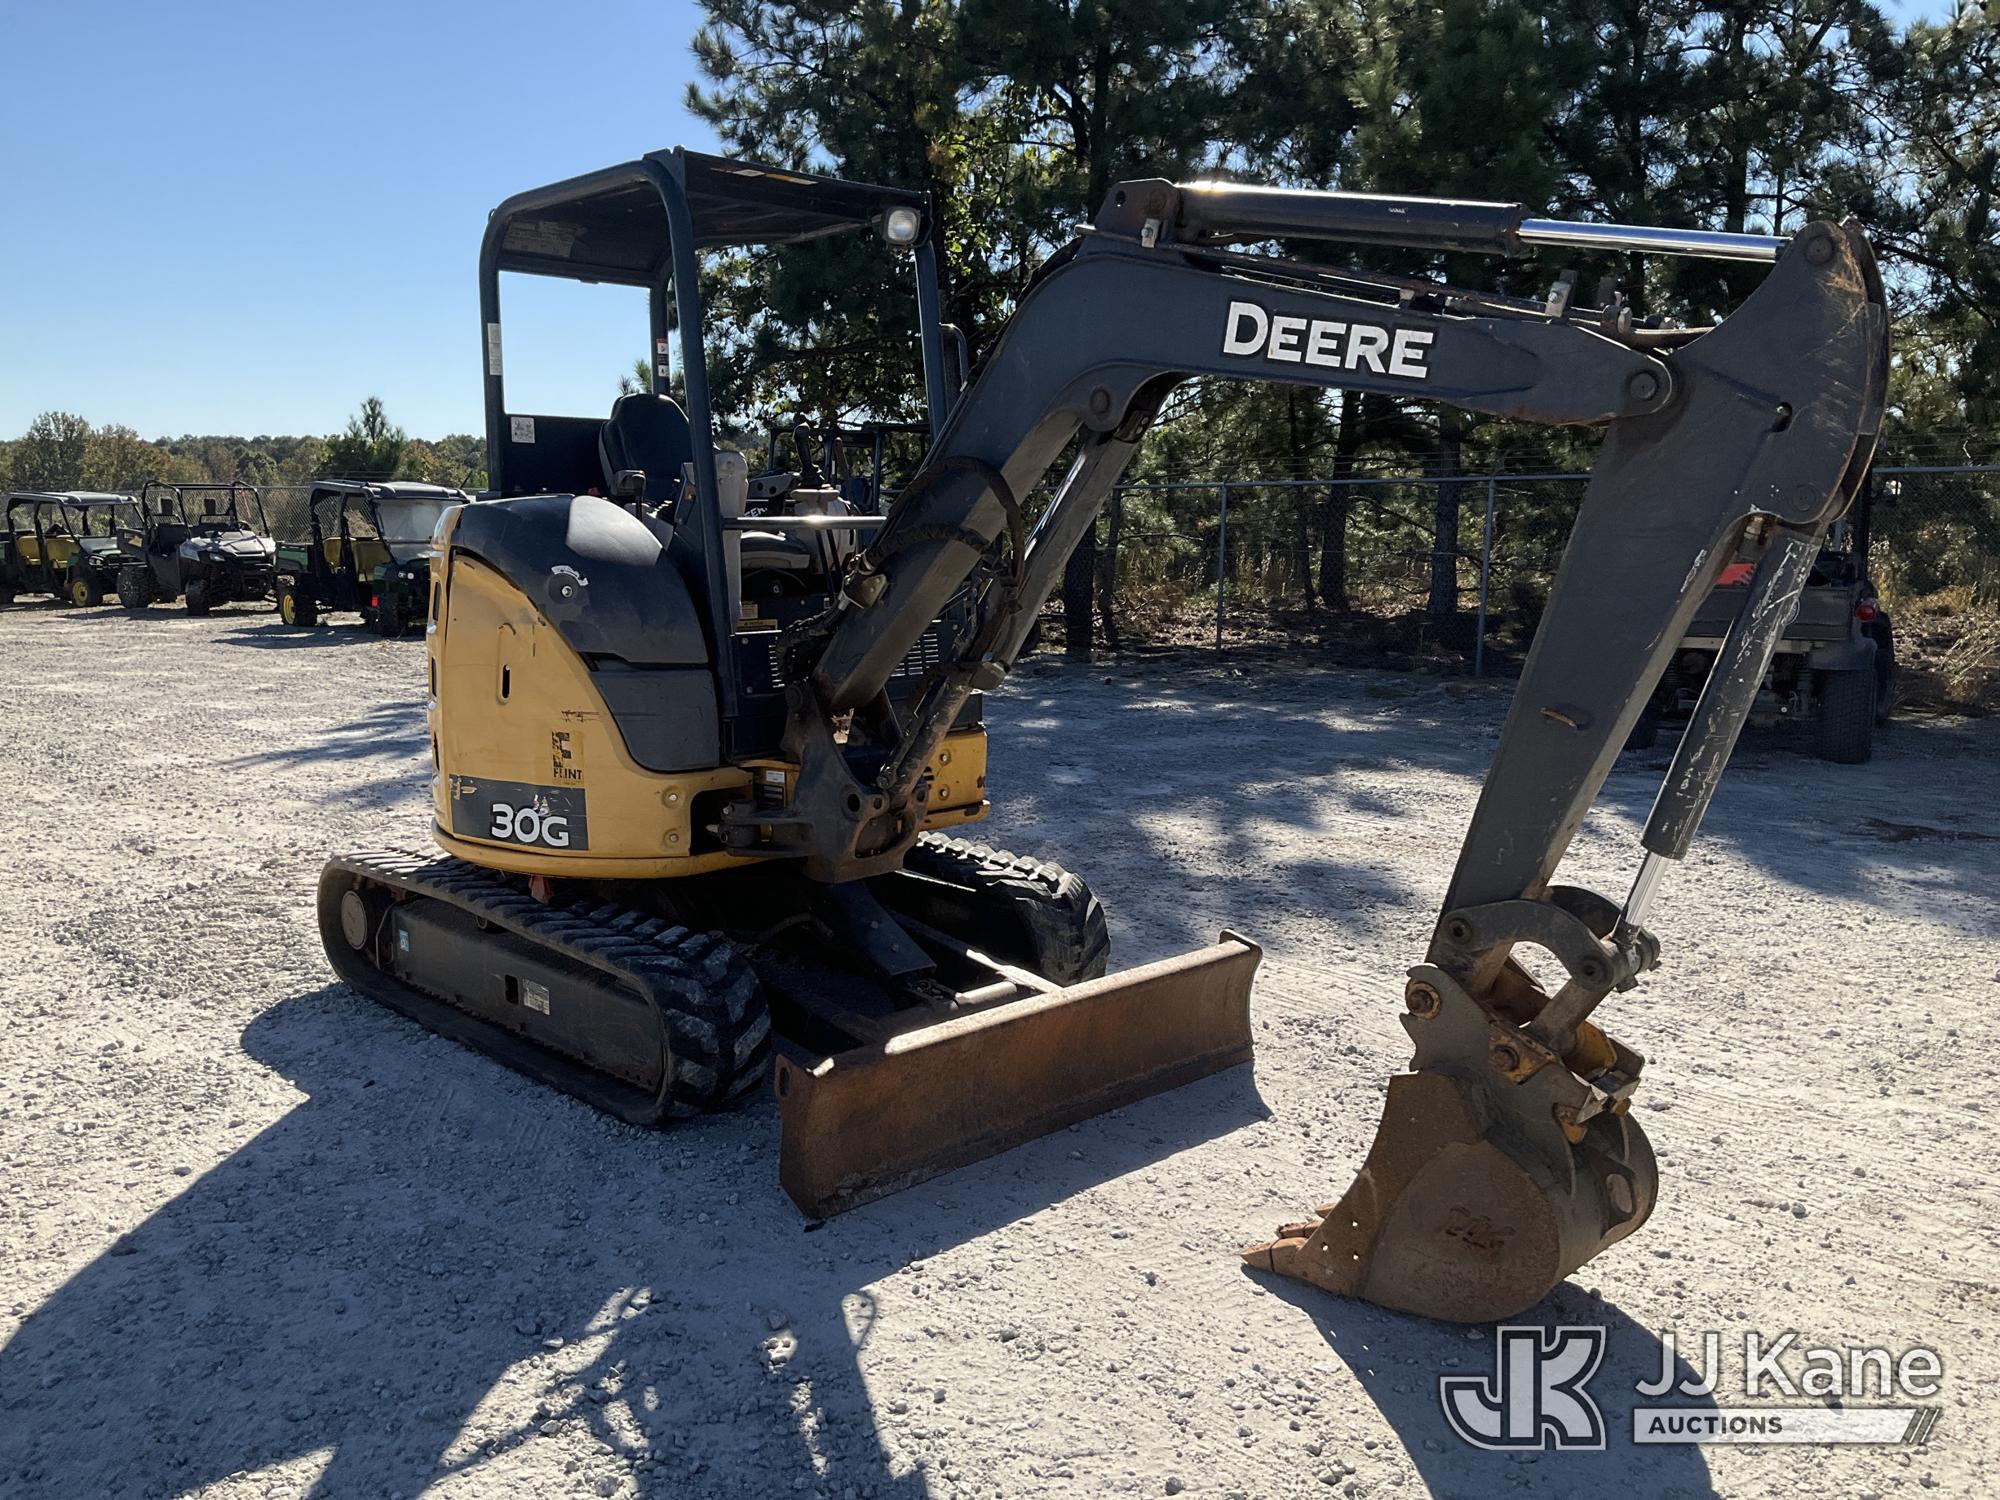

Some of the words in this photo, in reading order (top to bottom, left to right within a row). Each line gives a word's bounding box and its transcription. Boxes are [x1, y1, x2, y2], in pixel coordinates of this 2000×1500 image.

[1223, 301, 1434, 379] DEERE
[553, 767, 582, 780] FLINT
[491, 803, 569, 847] 30G
